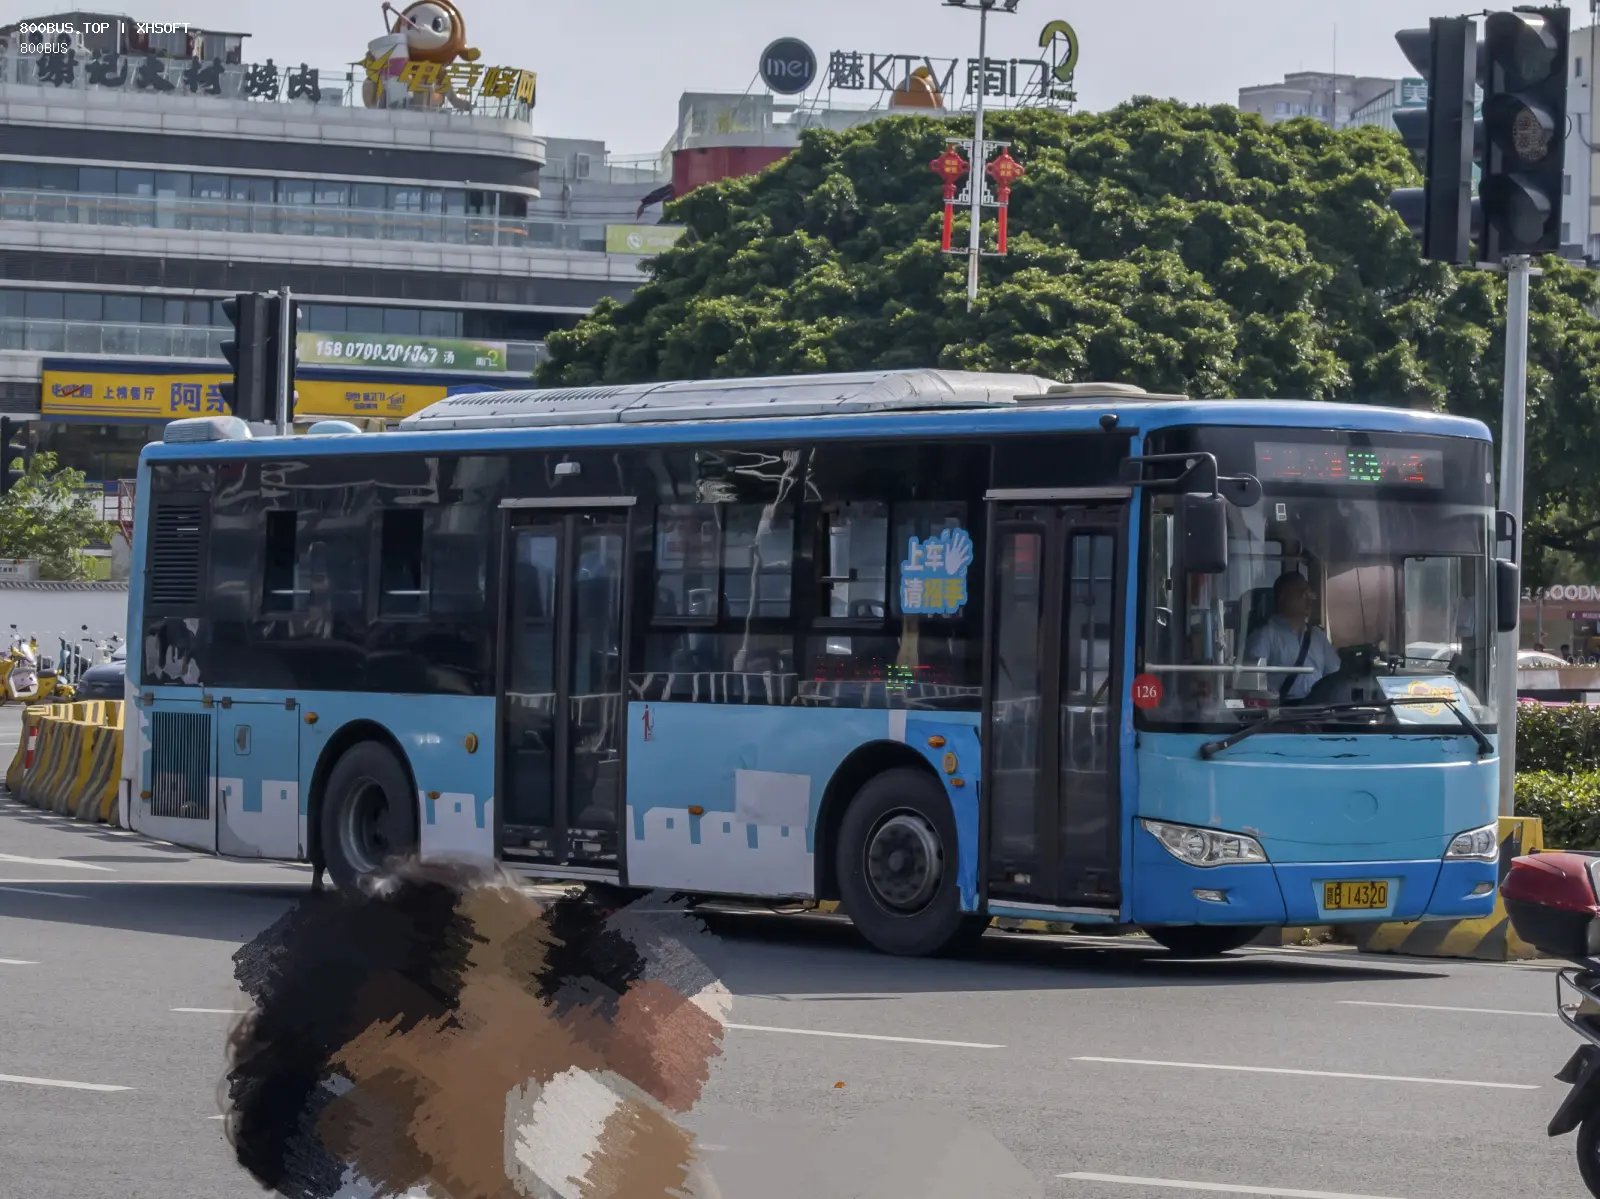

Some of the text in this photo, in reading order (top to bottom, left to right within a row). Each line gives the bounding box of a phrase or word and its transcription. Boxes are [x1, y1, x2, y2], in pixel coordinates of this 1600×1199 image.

[904, 541, 944, 573] 上车
[904, 578, 964, 609] 请招手
[1136, 685, 1157, 698] 126
